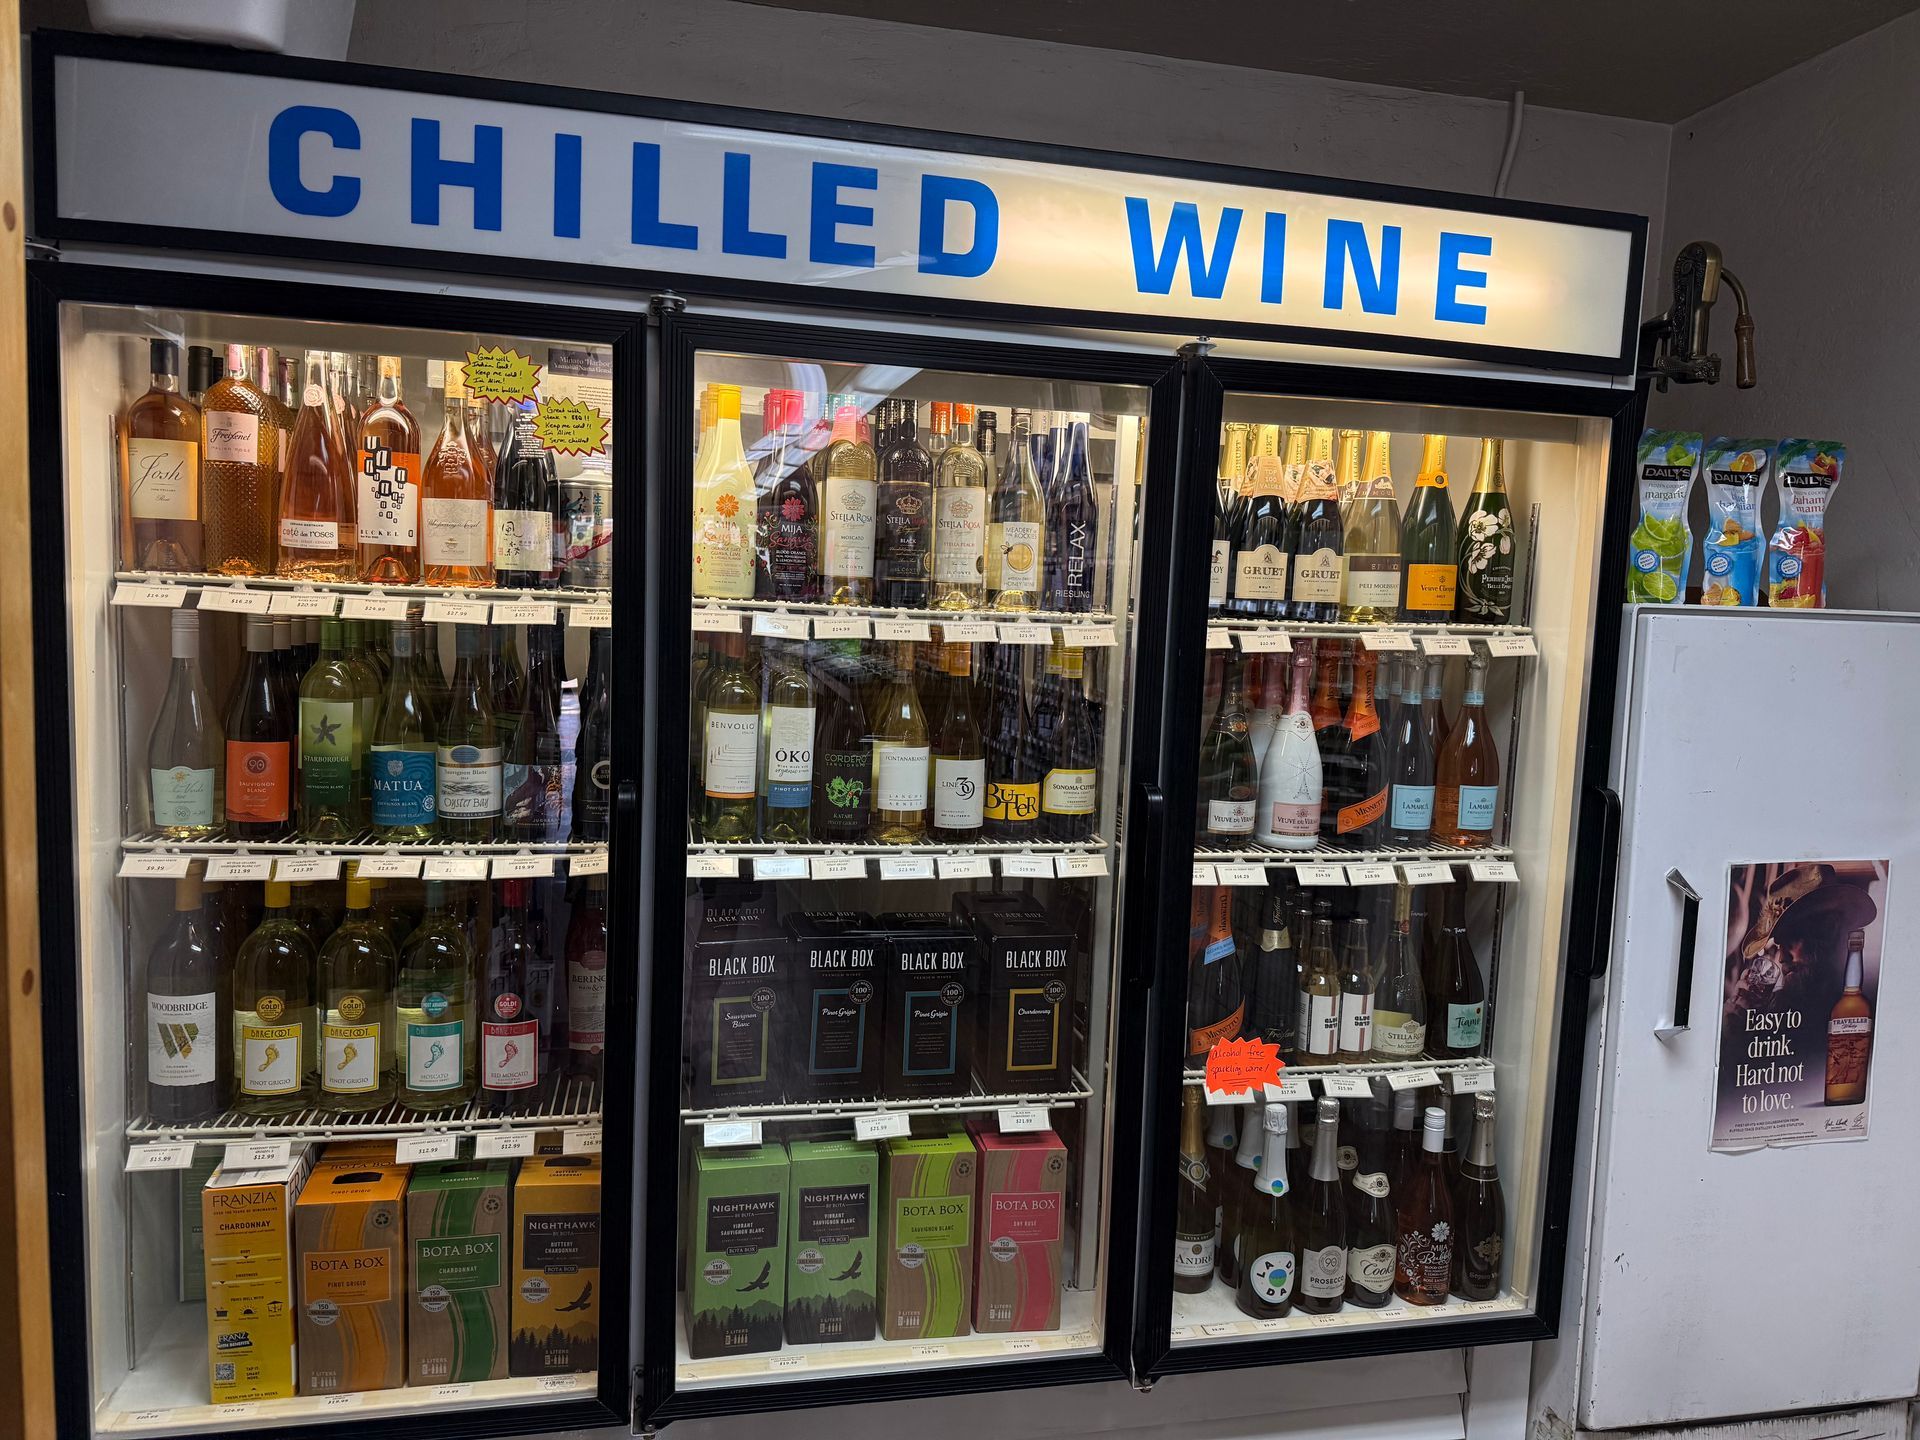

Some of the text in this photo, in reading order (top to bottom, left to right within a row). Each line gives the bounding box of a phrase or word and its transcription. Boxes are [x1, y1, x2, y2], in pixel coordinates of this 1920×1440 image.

[268, 105, 1492, 325] CHILLED WINE
[210, 427, 252, 443] Freixenet
[131, 452, 184, 497] Josh
[1645, 467, 1691, 478] DAILY'S
[1714, 472, 1759, 482] DAILY'S
[1786, 475, 1832, 485] DAILY'S
[830, 511, 873, 523] STELLA ROSA
[782, 524, 803, 534] MIJA
[938, 518, 981, 529] STELLA ROSA
[1243, 566, 1285, 577] GRUET
[1300, 569, 1340, 579] GRUET
[1055, 589, 1090, 599] RIESLING
[711, 720, 755, 730] BENVOLIO
[304, 755, 349, 763] STARBOROUGH
[775, 747, 811, 763] ÖKO
[825, 754, 867, 763] CORDERO
[249, 760, 265, 769] 90
[374, 779, 423, 791] MATUA
[955, 777, 975, 801] 39
[810, 949, 874, 968] BLACK BOX
[901, 951, 964, 971] BLACK BOX
[1005, 949, 1067, 969] BLACK BOX
[709, 955, 776, 976] BLACK BOX
[151, 1001, 209, 1012] WOODBRIDGE
[1017, 1007, 1051, 1016] Chardonnay
[724, 1012, 757, 1021] Sauvignon
[822, 1008, 856, 1017] Pinot Grigio
[930, 1010, 949, 1019] Grigio
[732, 1020, 750, 1028] Blanc
[1745, 1008, 1802, 1035] Easy to
[1832, 1018, 1868, 1026] TRAVELLER
[250, 1028, 290, 1039] BAREFOOT
[330, 1028, 368, 1038] BAREFOOT
[1247, 1044, 1265, 1057] free
[1747, 1034, 1795, 1058] drink.
[502, 1071, 529, 1079] MOSCATO
[1211, 1062, 1242, 1079] sparkling
[1736, 1061, 1804, 1087] Hard not
[268, 1078, 291, 1086] GRIGIO
[1742, 1089, 1794, 1114] to love.
[212, 1191, 276, 1209] FRANZIA
[804, 1192, 865, 1203] NIGHTHAWK
[712, 1201, 775, 1213] NIGHTHAWK
[903, 1203, 964, 1217] BOTA BOX
[995, 1199, 1056, 1211] BOTA BOX
[219, 1219, 271, 1231] CHARDONNAY
[529, 1221, 596, 1230] NIGHTHAWK
[911, 1225, 937, 1233] SAUVIGNON
[422, 1242, 494, 1258] BOTA BOX
[1430, 1244, 1448, 1252] MIJA
[311, 1257, 384, 1271] BOTA BOX
[1325, 1257, 1337, 1267] 90
[438, 1266, 478, 1274] CHARDONNAY
[1310, 1275, 1344, 1285] PROSECCO
